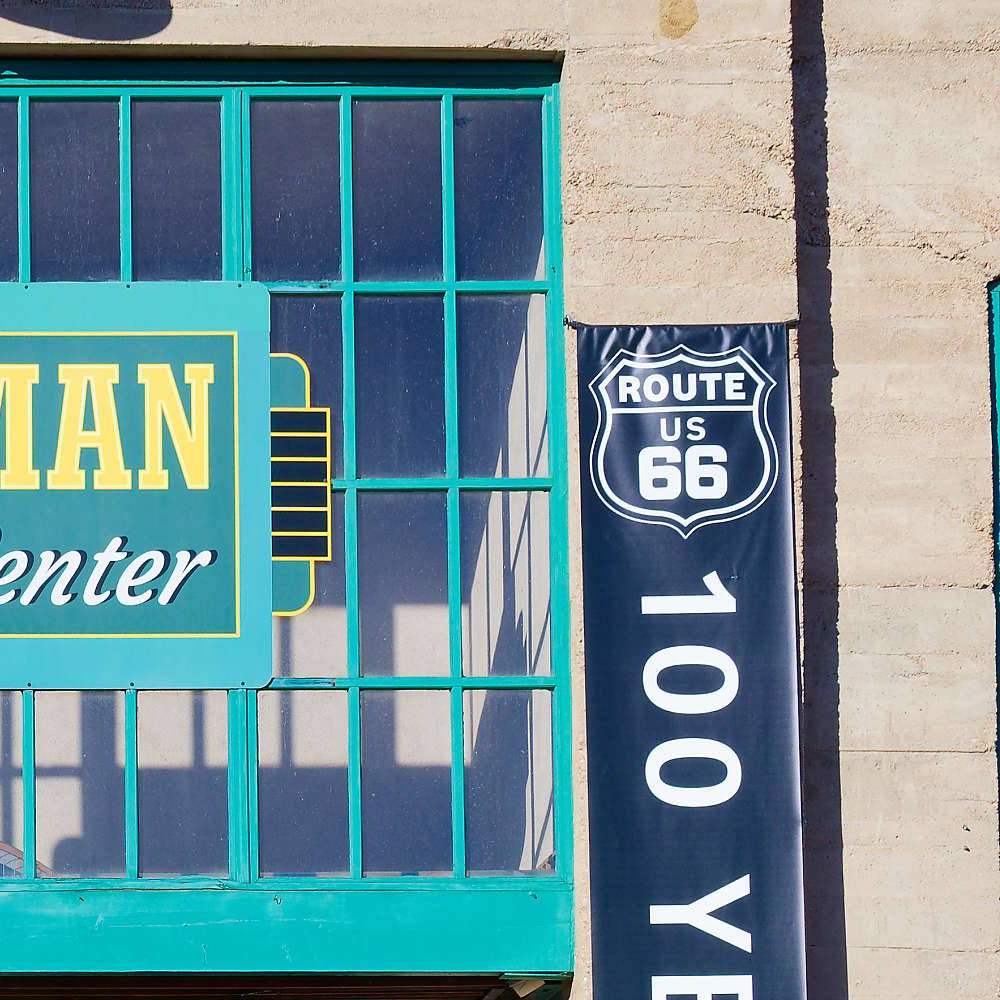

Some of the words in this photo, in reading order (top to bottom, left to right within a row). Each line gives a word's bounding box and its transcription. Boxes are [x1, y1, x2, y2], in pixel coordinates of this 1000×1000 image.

[618, 372, 746, 403] ROUTE
[660, 417, 706, 441] US
[638, 445, 728, 500] 66
[641, 570, 743, 808] 100
